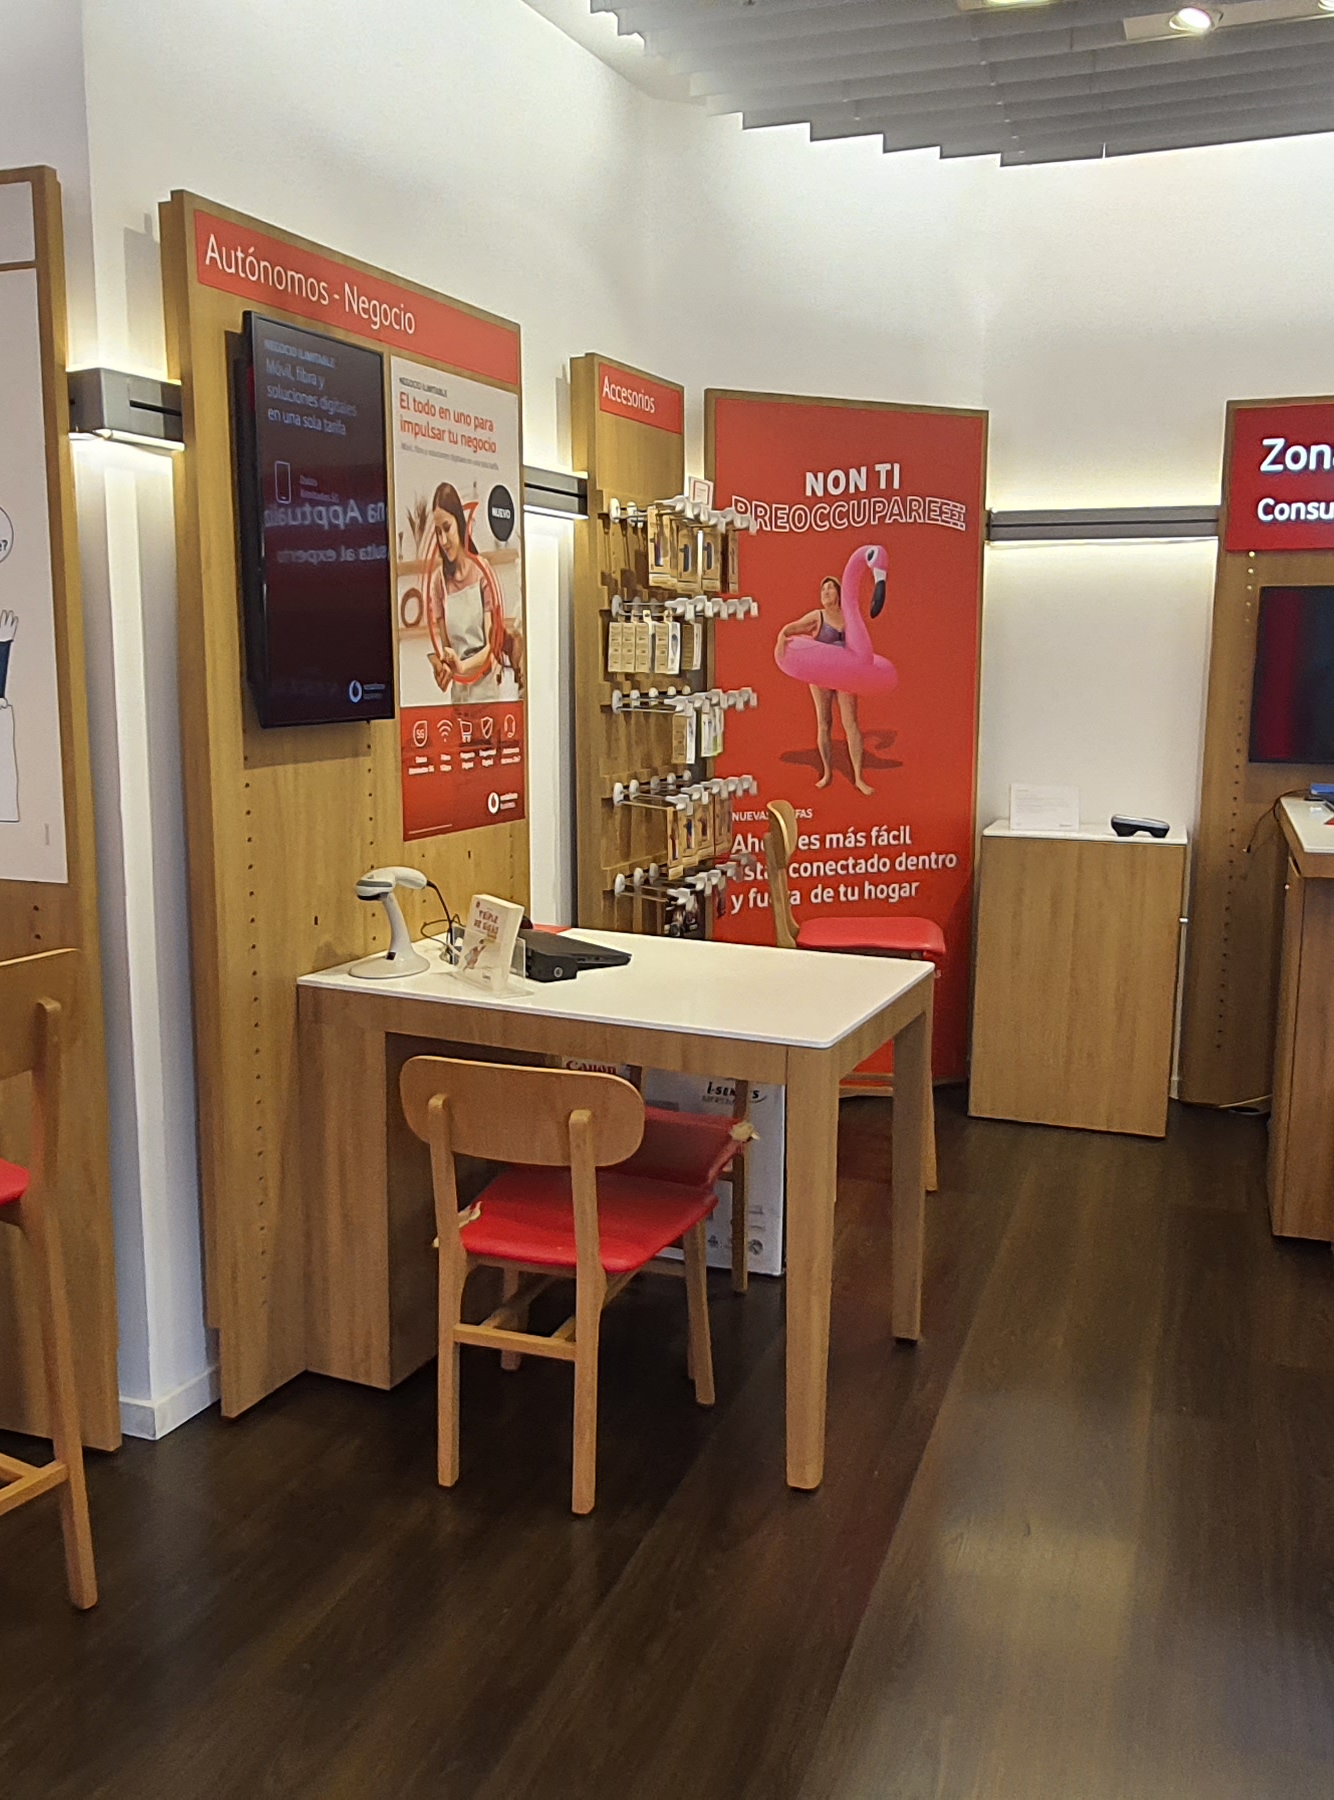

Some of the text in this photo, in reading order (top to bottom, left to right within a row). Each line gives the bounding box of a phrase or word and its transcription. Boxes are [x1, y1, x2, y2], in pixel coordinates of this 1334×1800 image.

[205, 232, 331, 307] Autónomos
[343, 281, 416, 336] Negocio
[399, 390, 495, 433] El todo en uno para
[602, 375, 656, 415] Accesorios
[268, 408, 281, 422] en
[282, 410, 302, 427] una
[399, 414, 498, 454] impulsar tu negocio
[805, 462, 901, 497] NON TI
[797, 824, 912, 851] es más fácil
[788, 853, 891, 879] conectado
[894, 851, 958, 872] dentro
[730, 880, 921, 915] y fua de tu hogar
